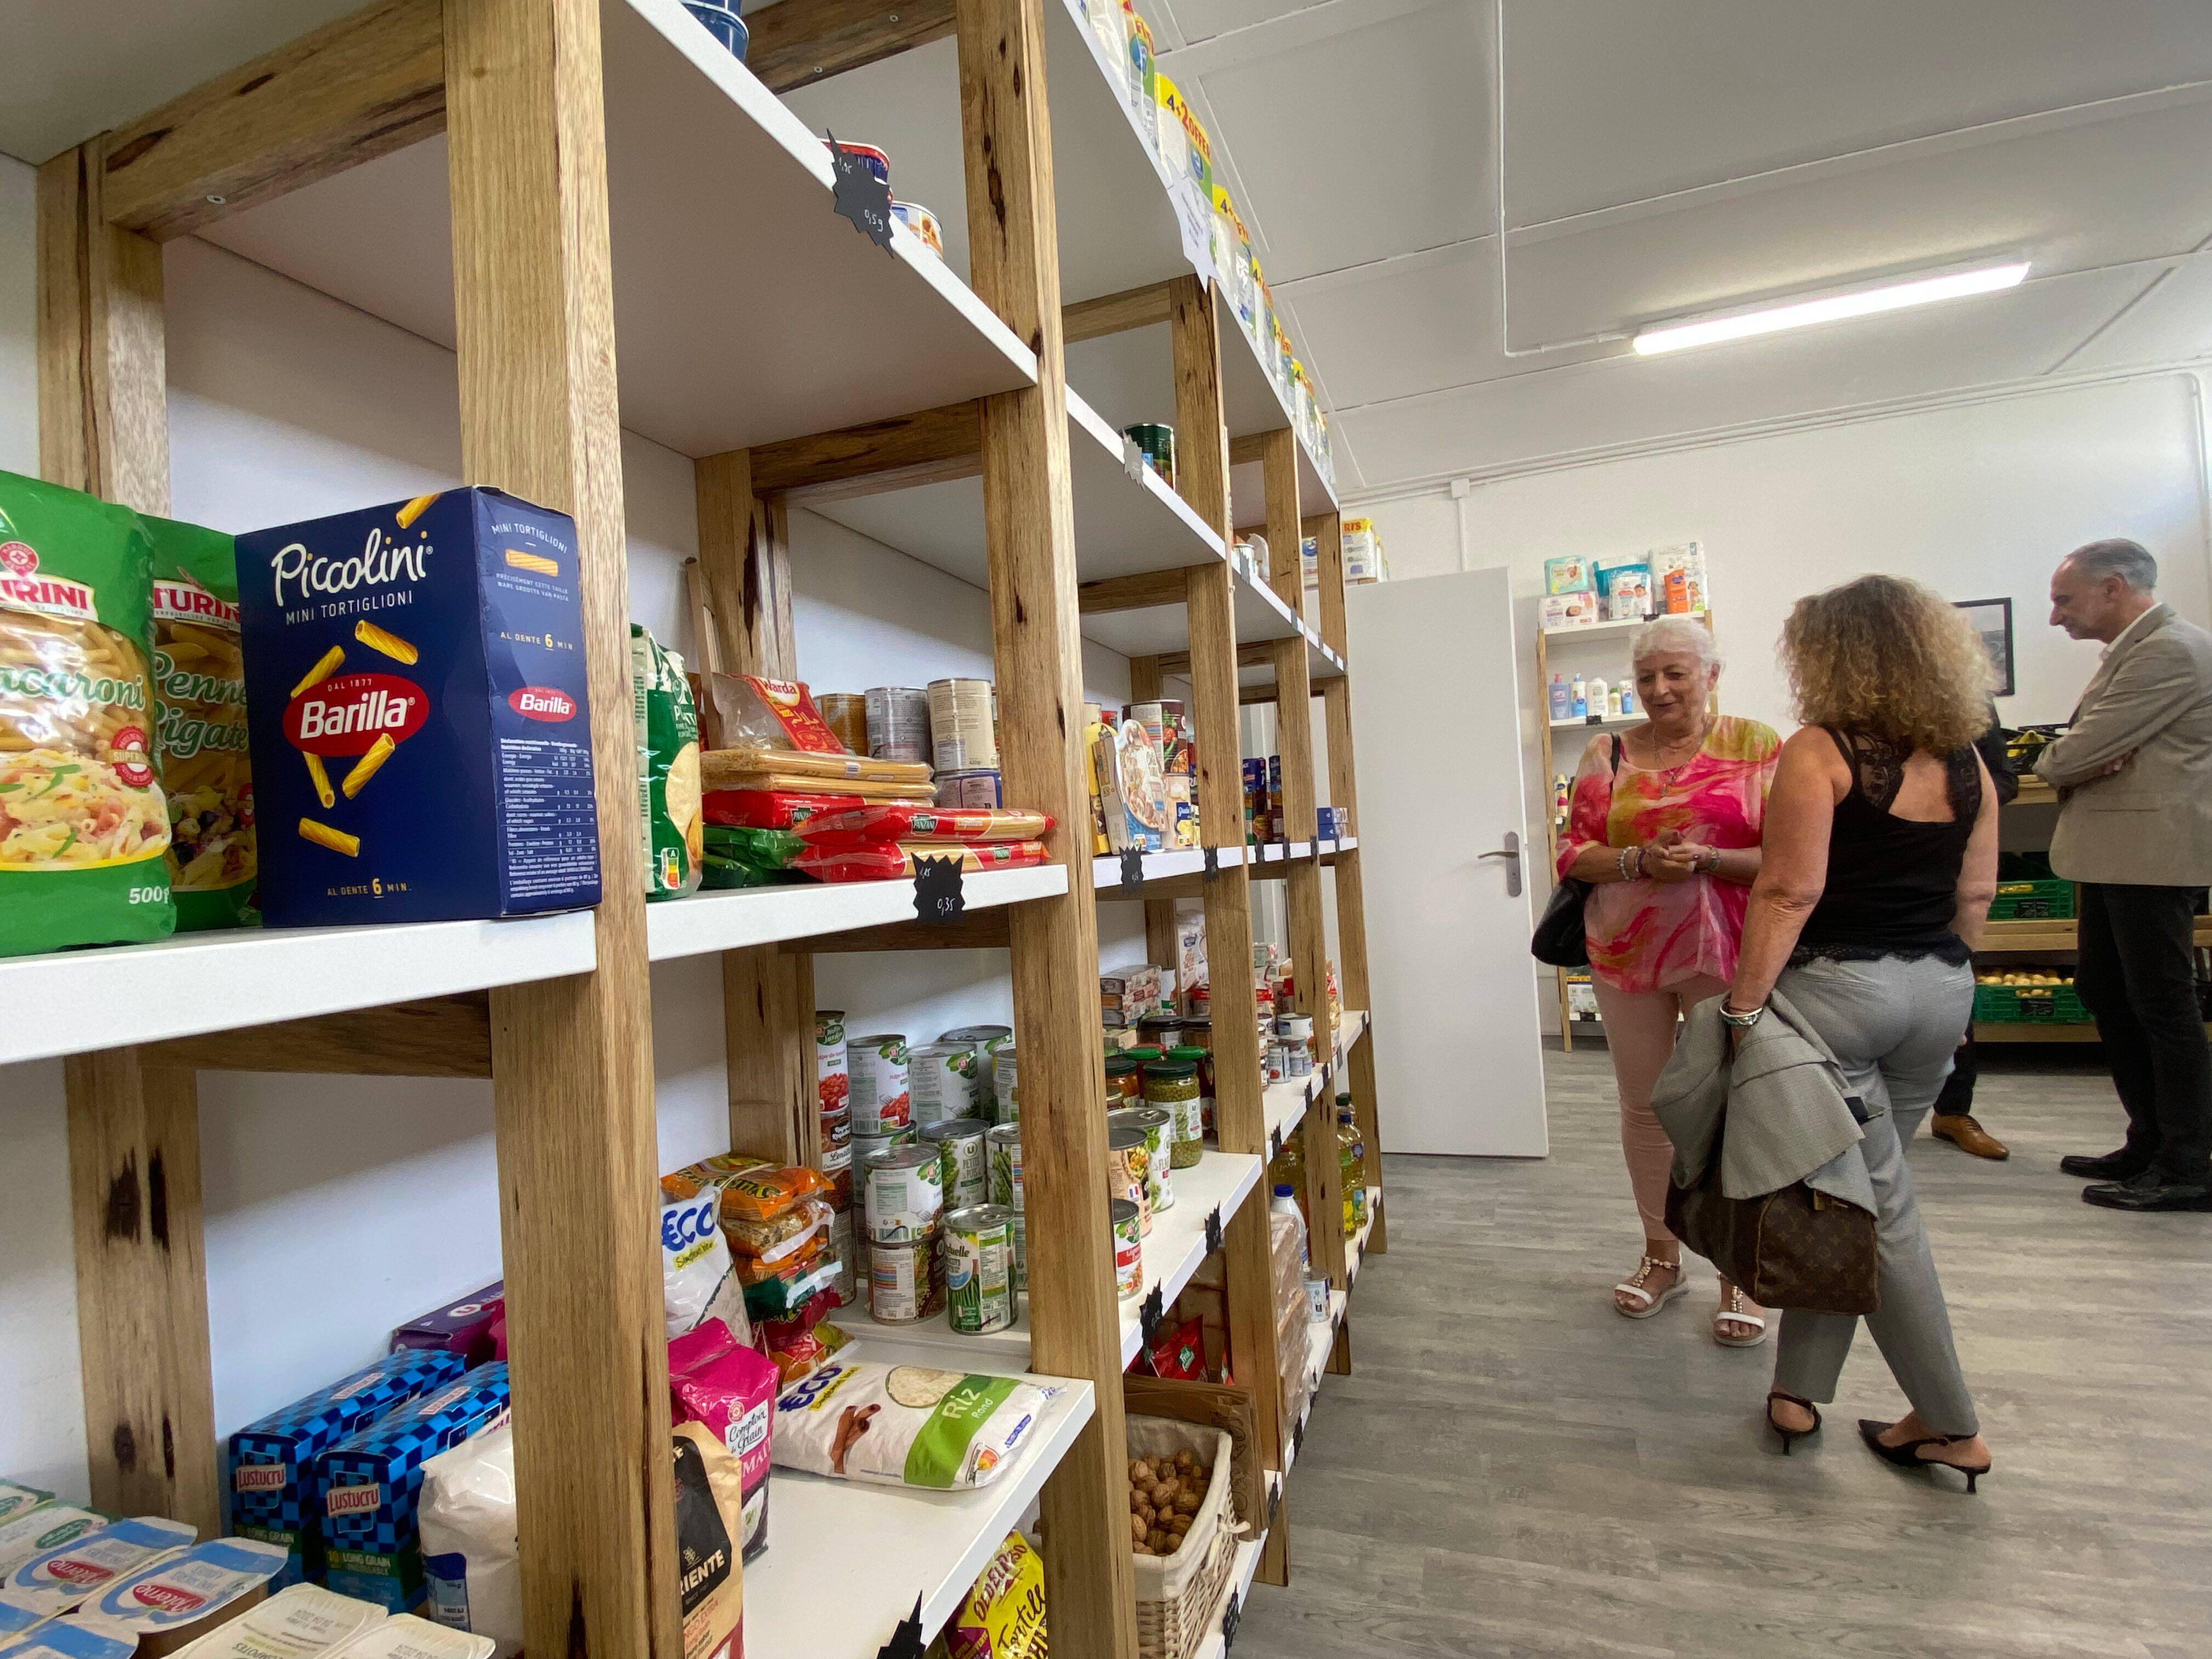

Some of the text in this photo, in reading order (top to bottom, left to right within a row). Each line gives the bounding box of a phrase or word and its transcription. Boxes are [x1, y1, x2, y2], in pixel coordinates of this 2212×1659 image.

[492, 523, 567, 554] MINI TORTIGLIONI
[270, 528, 427, 606] Piccolini
[286, 590, 413, 625] MINI TORTIGLIONI
[500, 631, 512, 640] AL
[515, 634, 541, 645] DENTE
[544, 633, 553, 648] 6
[300, 691, 409, 740] Barilla
[520, 693, 571, 715] Barilla
[328, 888, 336, 896] AL
[341, 885, 369, 896] DENTE
[373, 878, 382, 895] 6
[941, 1388, 981, 1420] Riz
[972, 1398, 994, 1420] Rond
[730, 1409, 766, 1442] Comptoir
[239, 1469, 285, 1488] Lustucru
[330, 1488, 379, 1512] Lustucru
[136, 1584, 204, 1613] Materne
